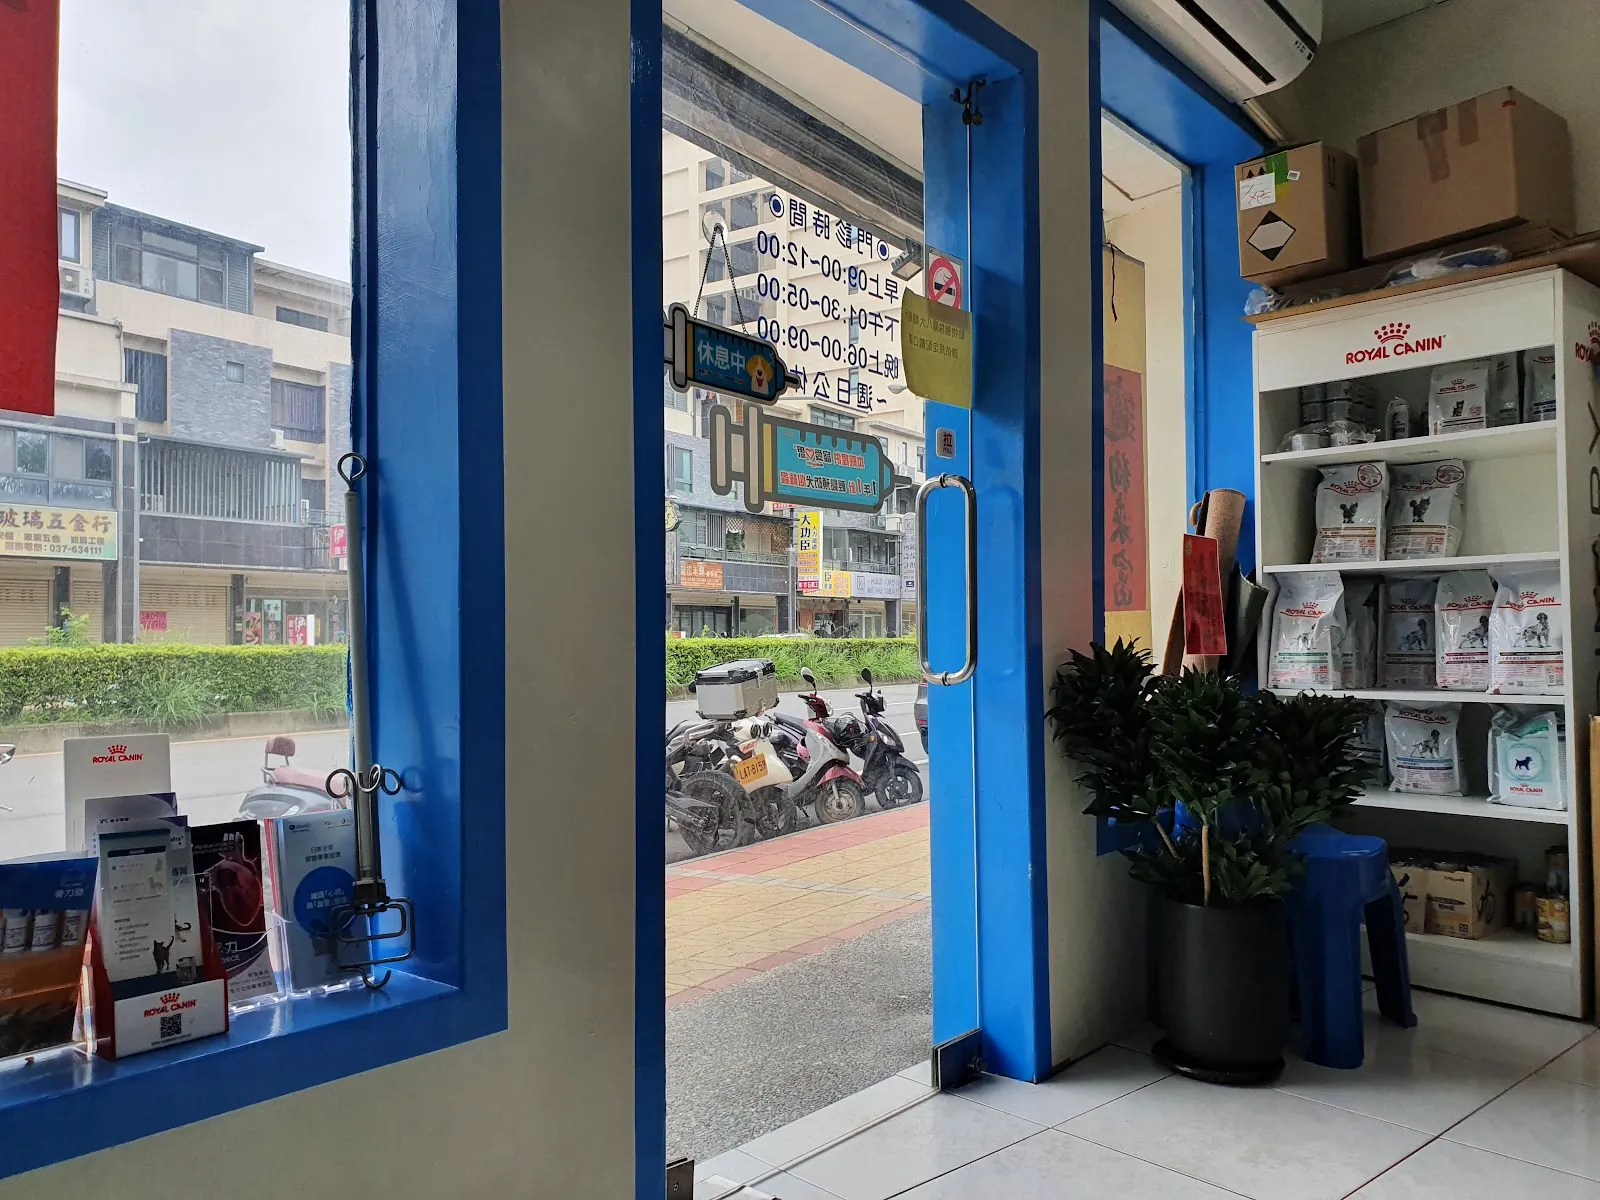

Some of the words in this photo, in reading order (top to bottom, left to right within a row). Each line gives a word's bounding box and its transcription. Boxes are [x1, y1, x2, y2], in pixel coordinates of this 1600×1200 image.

[697, 339, 746, 375] 休息中
[1345, 346, 1390, 365] ROYAL
[1393, 335, 1443, 356] CANIN
[943, 431, 953, 448] 拉
[800, 514, 811, 551] 大功臣
[1527, 596, 1555, 604] CANIN
[92, 755, 116, 764] ROYAL
[118, 753, 143, 762] CANIN
[144, 1005, 169, 1018] ROYAL
[170, 999, 196, 1011] CANIN
